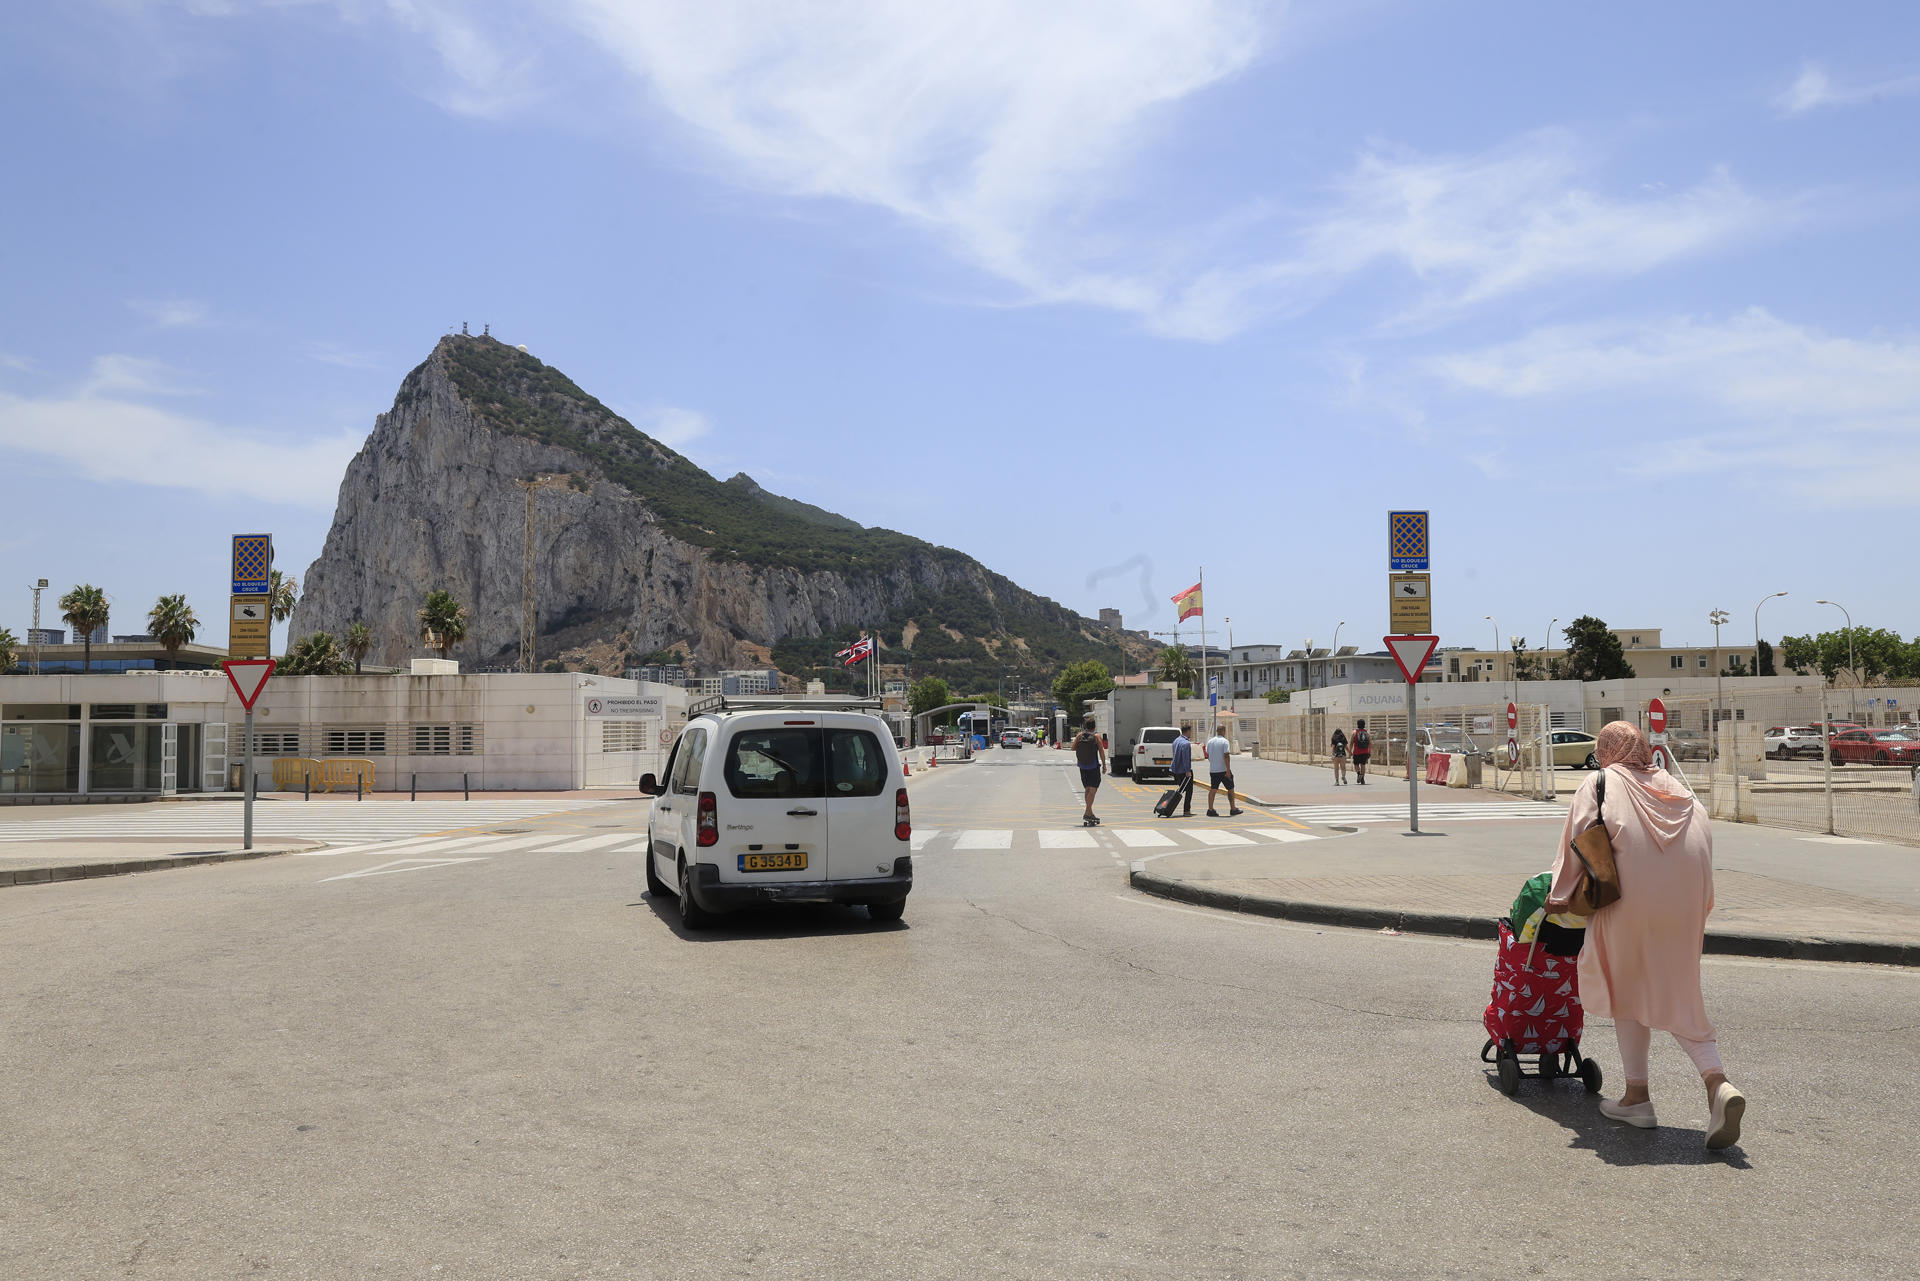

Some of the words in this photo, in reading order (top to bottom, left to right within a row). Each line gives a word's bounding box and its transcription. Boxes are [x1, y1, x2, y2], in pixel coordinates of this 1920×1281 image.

[1359, 696, 1403, 704] ADUANA
[750, 857, 757, 868] G
[760, 856, 791, 867] 3534
[794, 855, 801, 866] D
